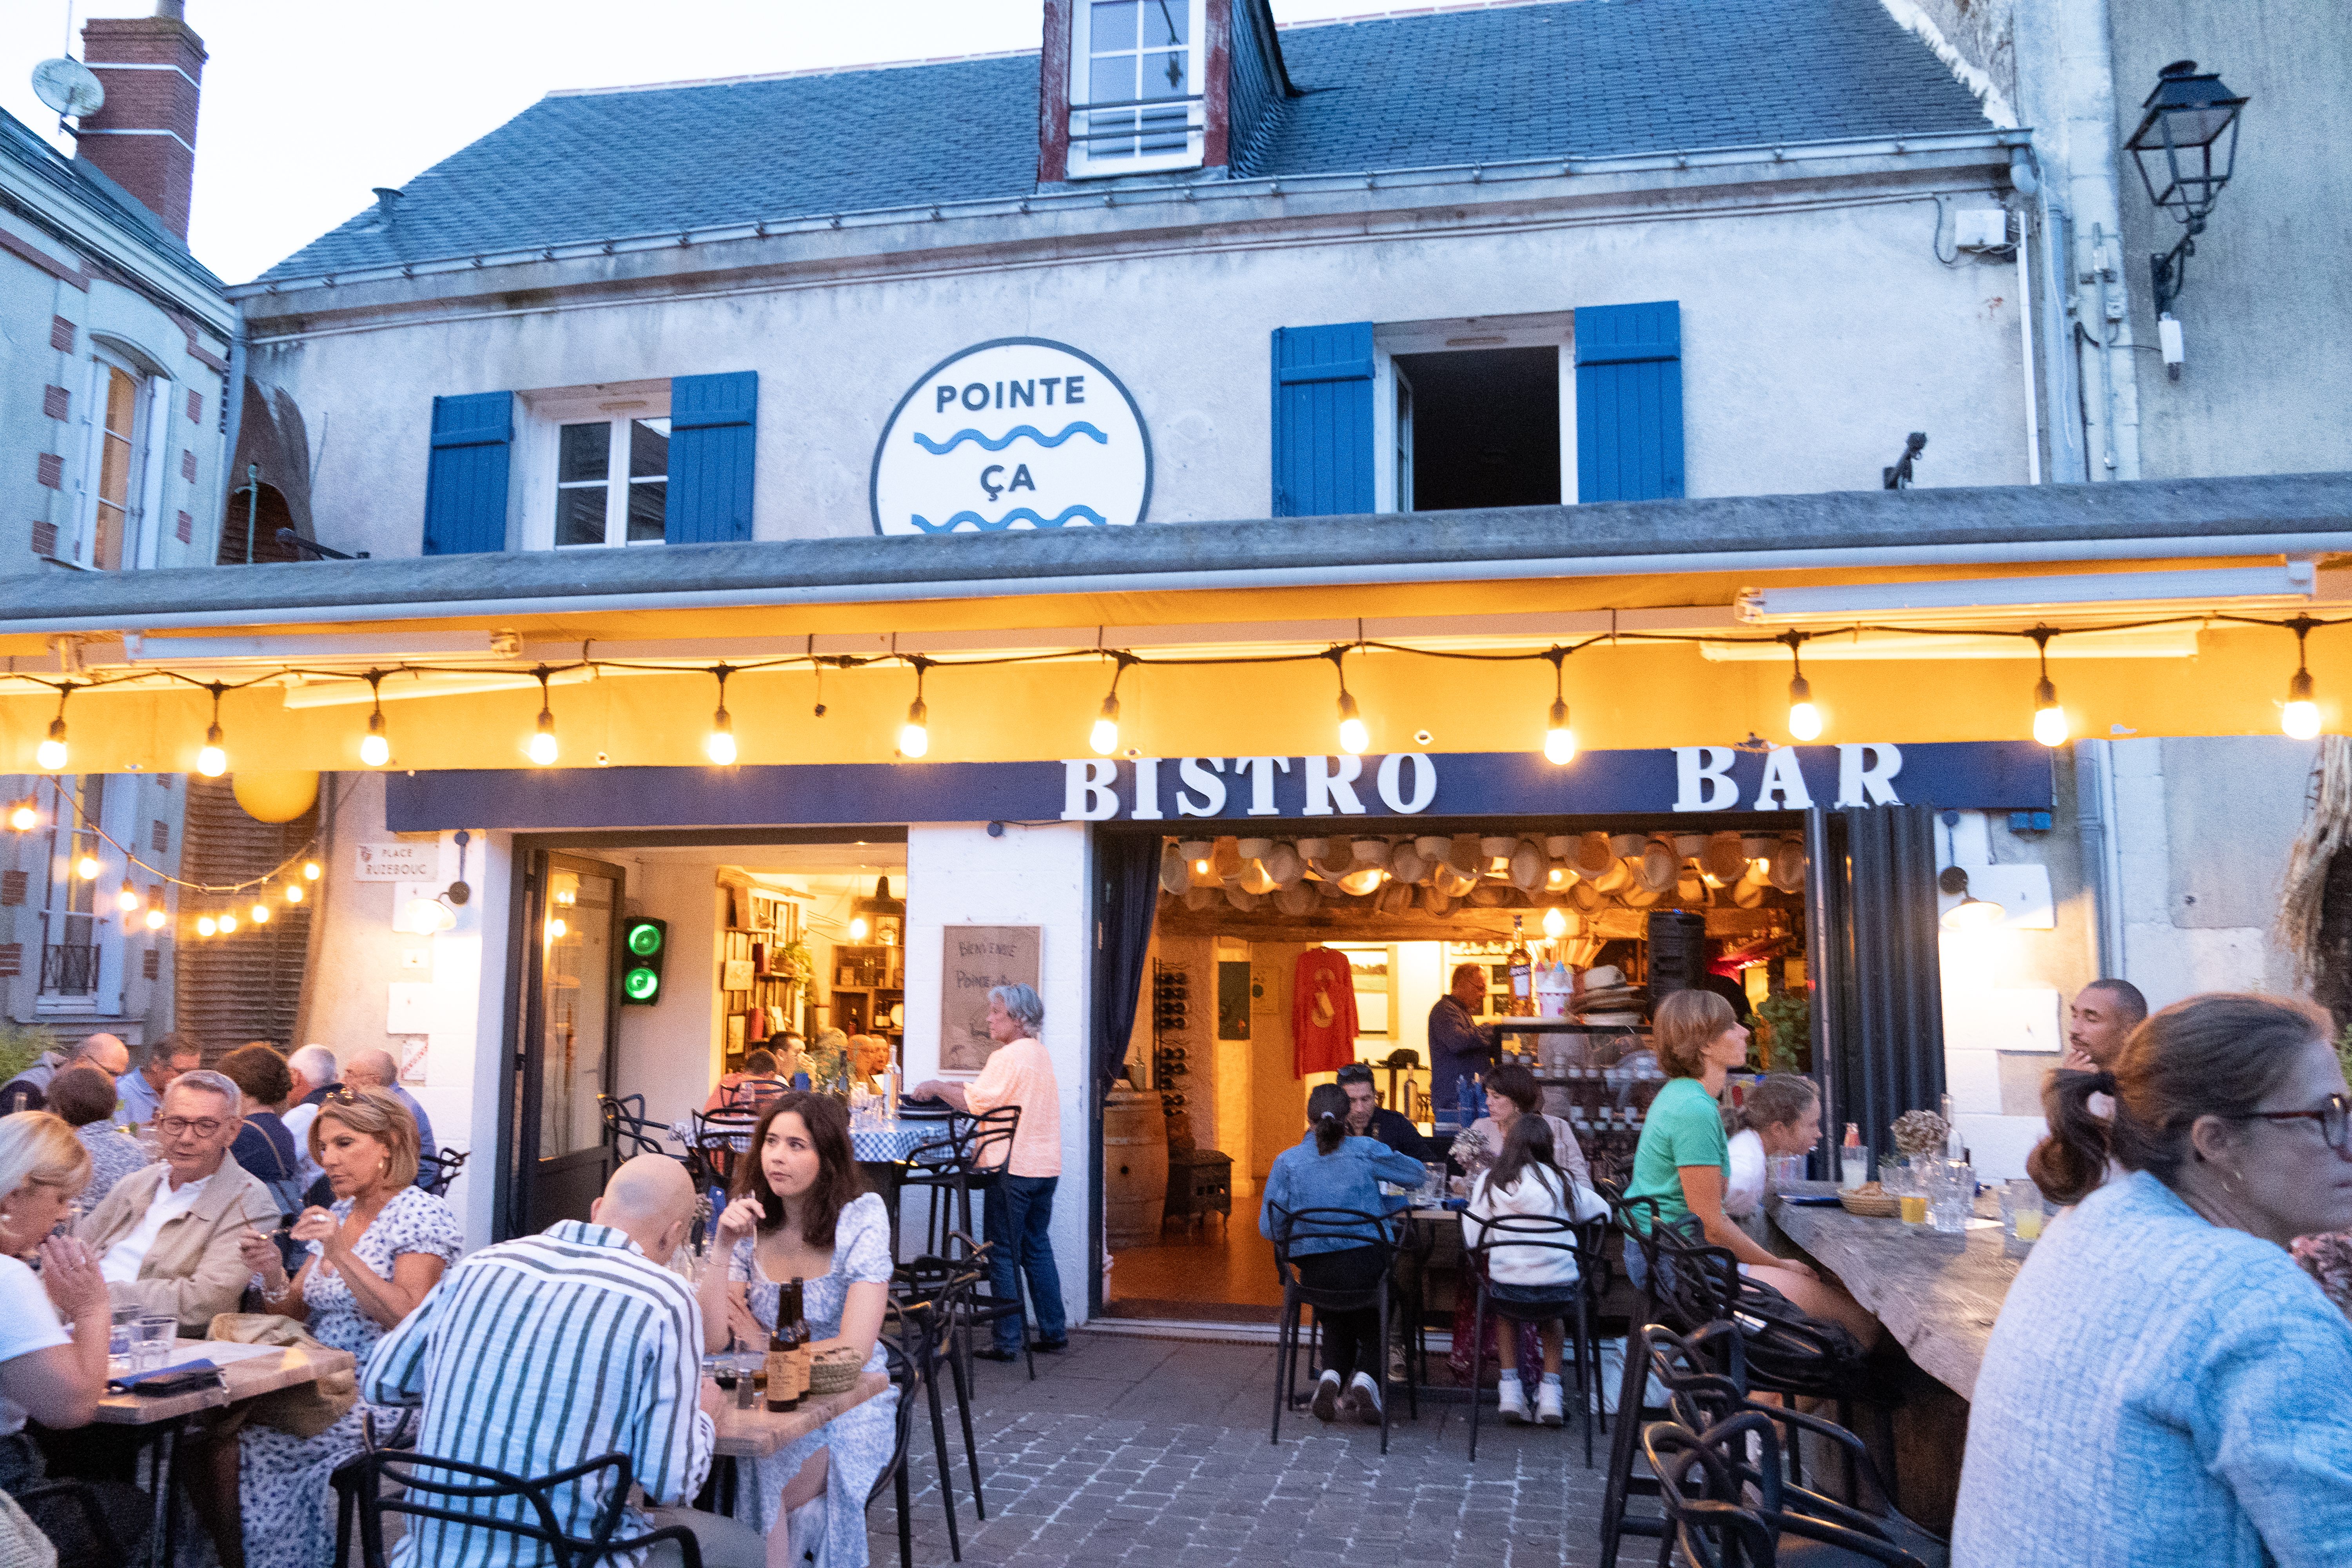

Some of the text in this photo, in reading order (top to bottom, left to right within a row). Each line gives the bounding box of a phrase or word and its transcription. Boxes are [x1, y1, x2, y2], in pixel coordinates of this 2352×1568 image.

[936, 376, 1085, 413] POINTE
[980, 464, 1036, 502] ÇA
[1060, 742, 1906, 821] BISTRO BAR
[382, 848, 412, 857] PLACE
